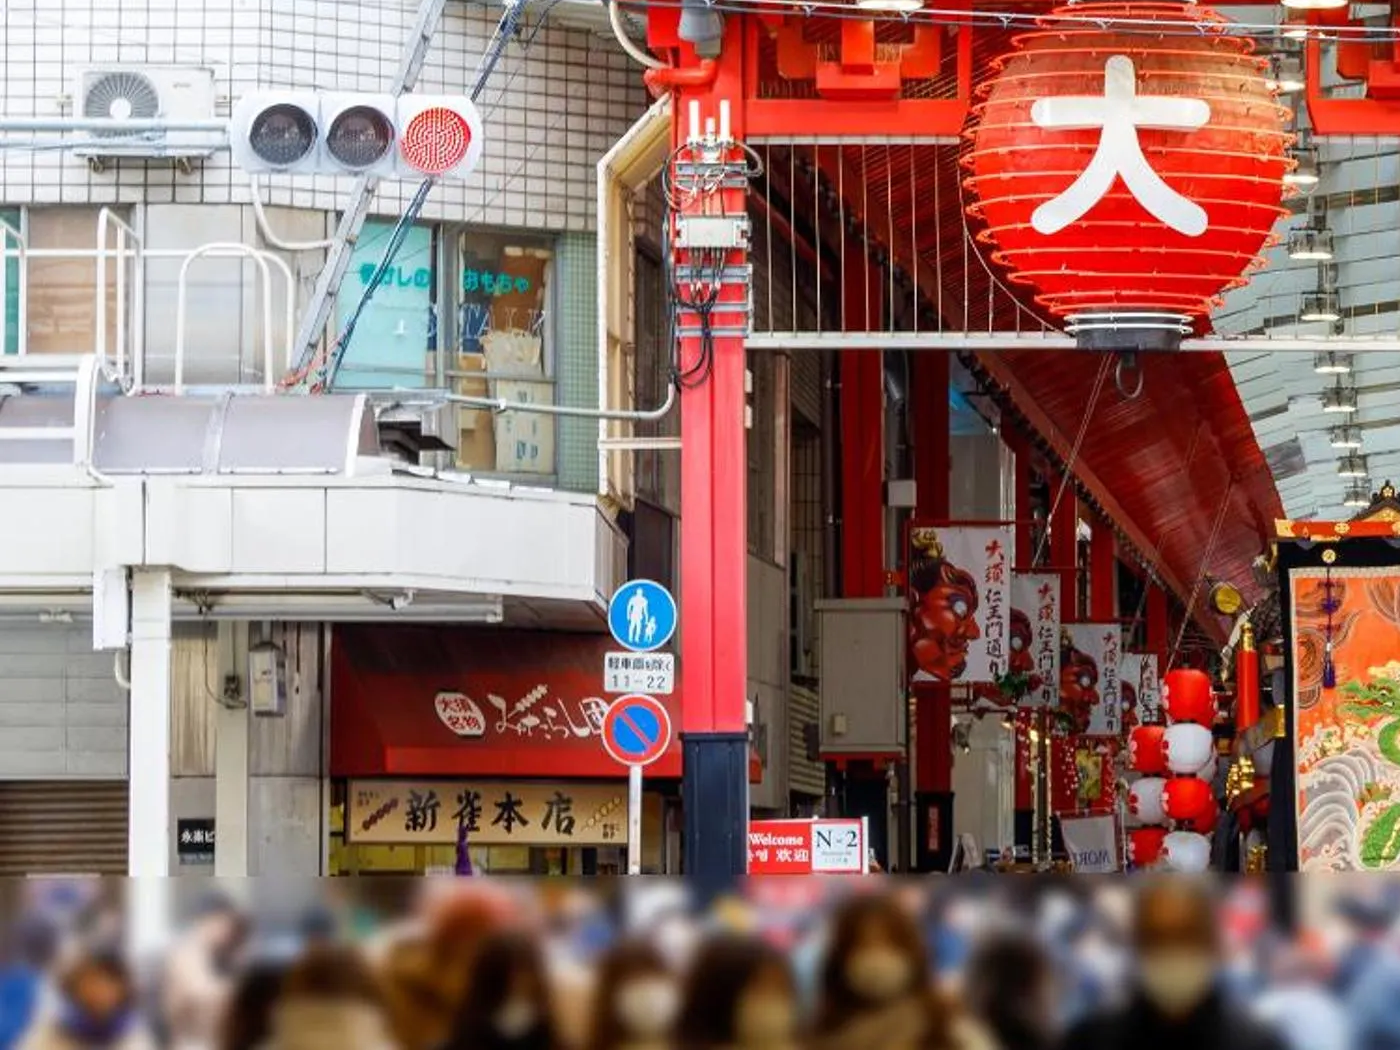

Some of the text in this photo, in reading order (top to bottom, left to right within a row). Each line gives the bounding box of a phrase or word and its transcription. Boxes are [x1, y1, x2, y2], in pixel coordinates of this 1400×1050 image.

[1030, 55, 1211, 237] 大
[613, 675, 666, 689] 11-22
[405, 789, 577, 837] 新雀本店
[748, 833, 803, 846] Welcome
